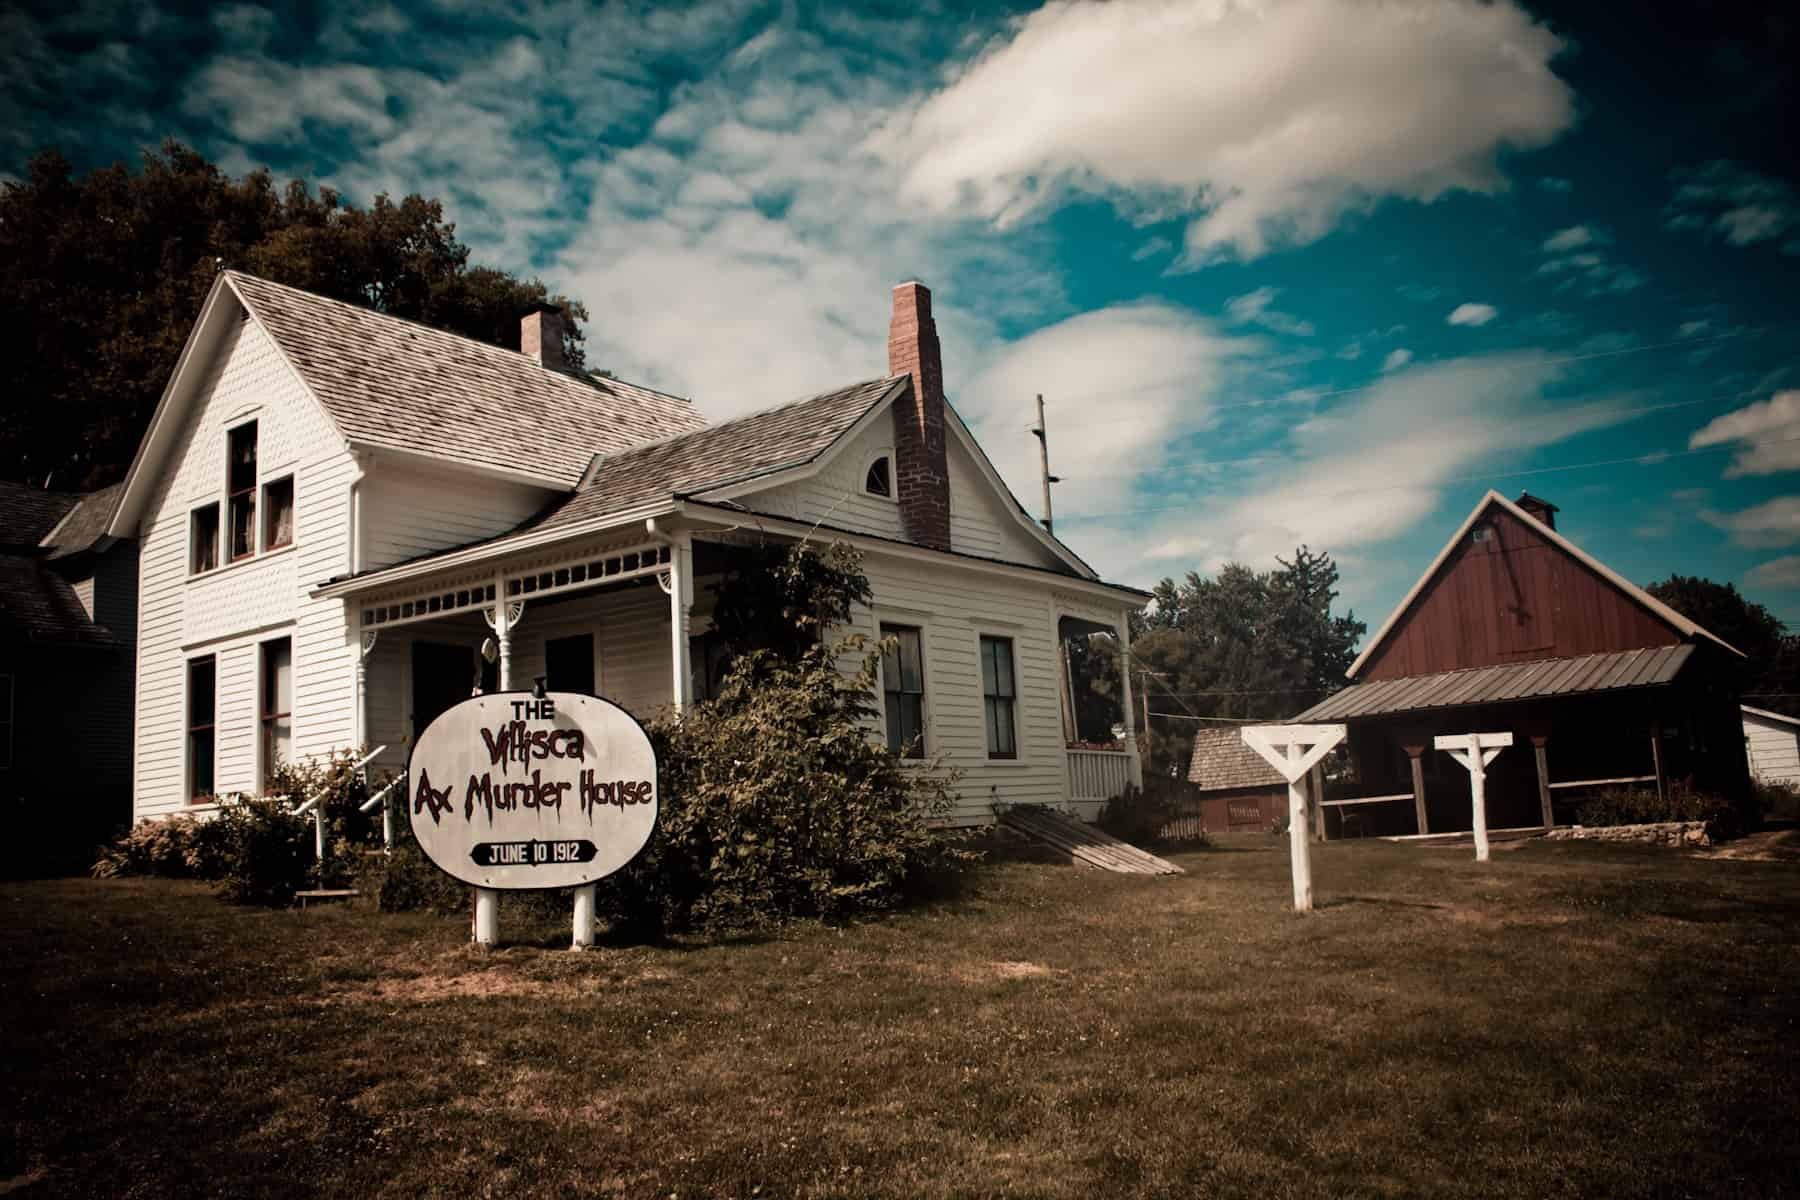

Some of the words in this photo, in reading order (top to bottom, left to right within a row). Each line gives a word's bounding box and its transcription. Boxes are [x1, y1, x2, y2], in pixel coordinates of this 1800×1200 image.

[511, 701, 555, 720] THE
[480, 720, 585, 776] Villisca
[414, 768, 454, 826] Ax
[465, 769, 572, 829] Murder
[579, 769, 653, 826] House
[489, 844, 528, 863] JUNE
[534, 843, 547, 861] 10
[553, 842, 580, 860] 1912
